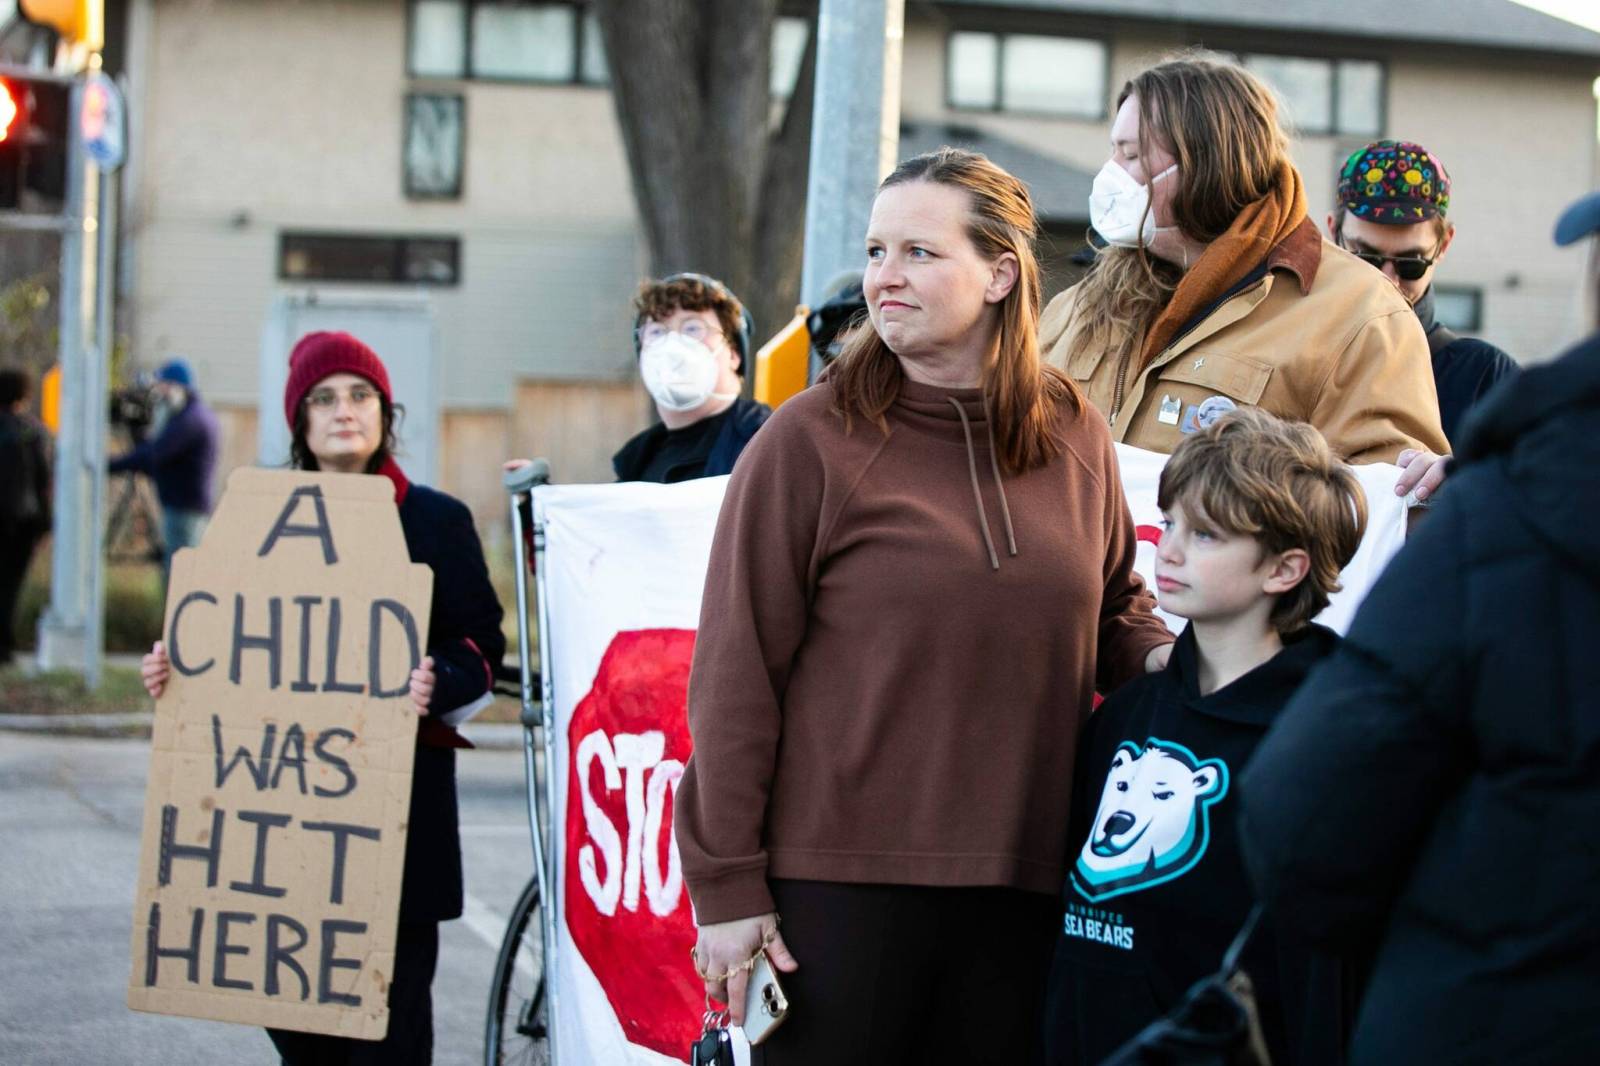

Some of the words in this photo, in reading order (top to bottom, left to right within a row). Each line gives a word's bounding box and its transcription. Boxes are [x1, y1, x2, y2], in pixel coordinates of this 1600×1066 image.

[1355, 204, 1424, 217] STAY
[258, 484, 338, 565] A
[169, 591, 420, 699] CHILD
[211, 713, 357, 799] WAS
[157, 805, 381, 905] HIT
[576, 728, 685, 918] STO
[145, 902, 368, 1006] HERE
[1064, 912, 1084, 937] SEA
[1086, 918, 1134, 950] BEARS
